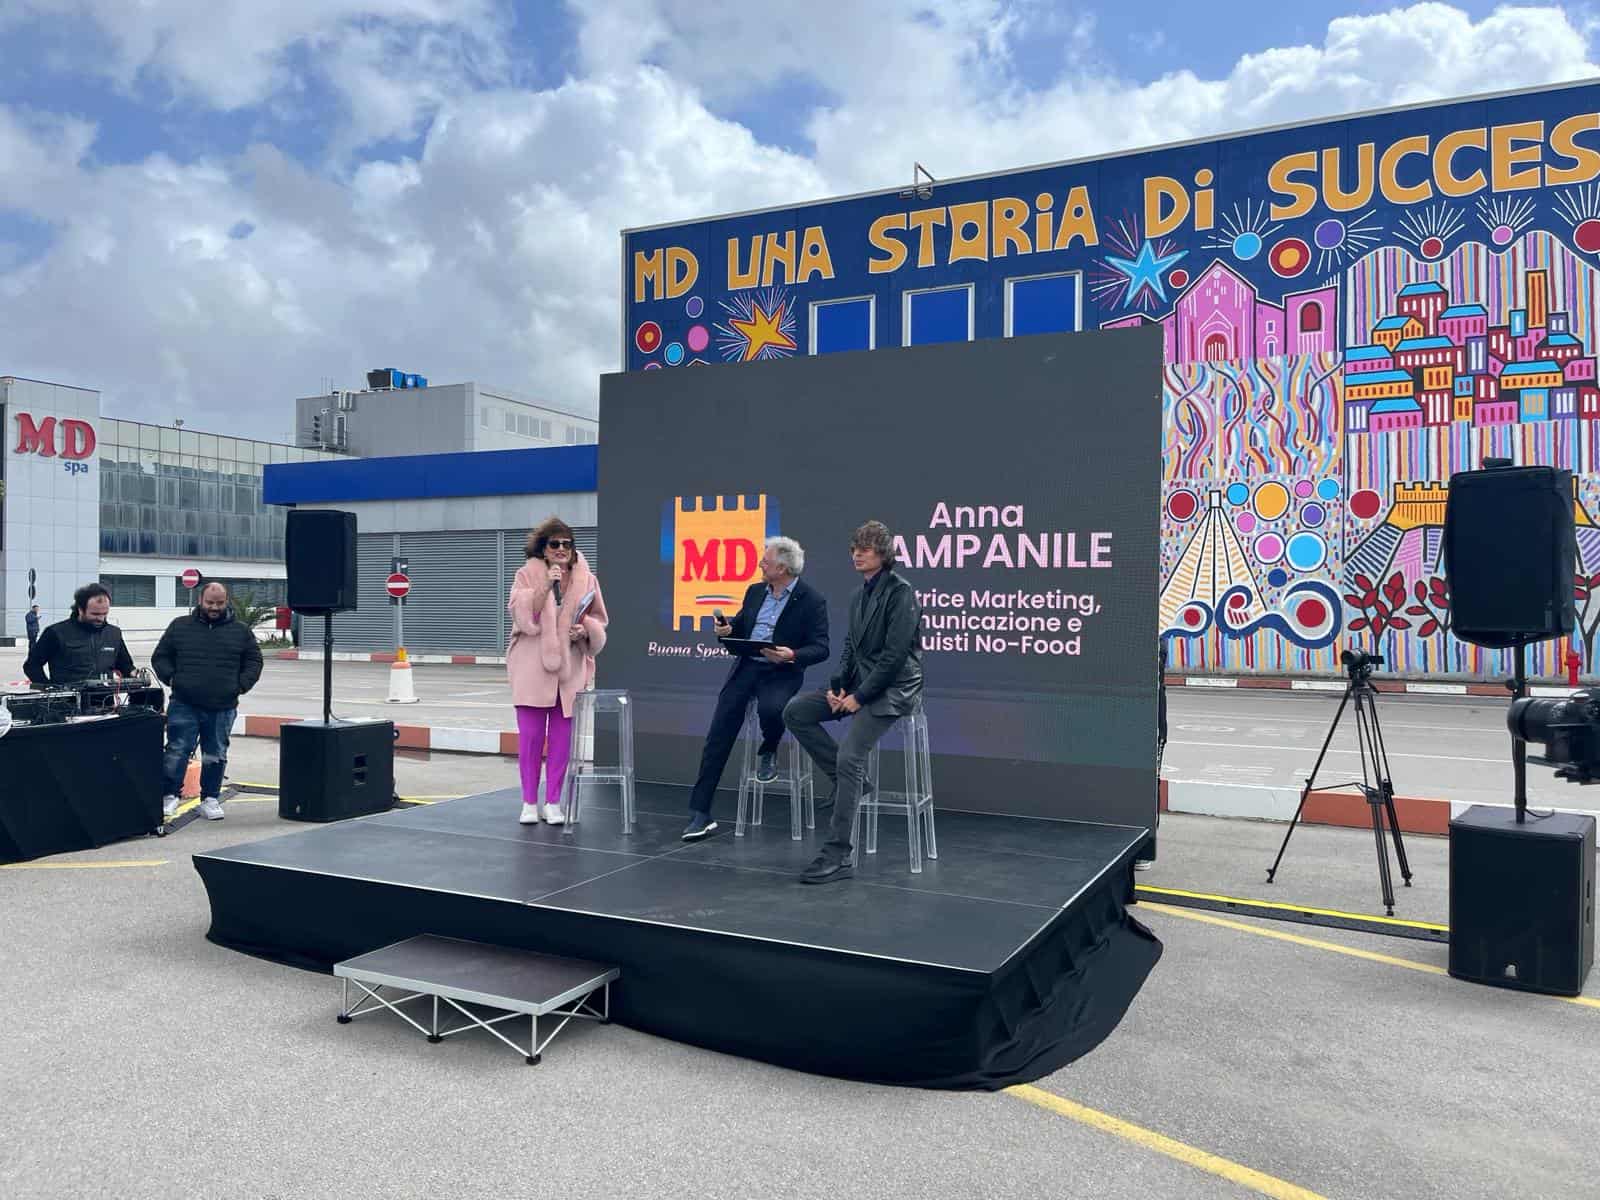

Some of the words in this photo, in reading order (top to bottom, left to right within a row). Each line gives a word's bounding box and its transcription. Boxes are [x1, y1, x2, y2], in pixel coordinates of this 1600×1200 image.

[634, 247, 699, 303] MD
[727, 225, 836, 291] UNA
[1267, 112, 1600, 222] SUCCES
[14, 412, 97, 460] MD
[64, 461, 89, 476] spa
[929, 502, 1024, 528] Anna
[681, 538, 758, 582] MD
[892, 532, 1113, 569] AMPANILE
[914, 588, 966, 608] trice
[970, 588, 1102, 616] Marketing,
[921, 610, 1061, 632] unicazione
[1067, 616, 1082, 633] e
[647, 641, 692, 657] Buona
[695, 643, 737, 661] Spes
[921, 631, 969, 652] uisti
[975, 634, 1081, 656] No-Food
